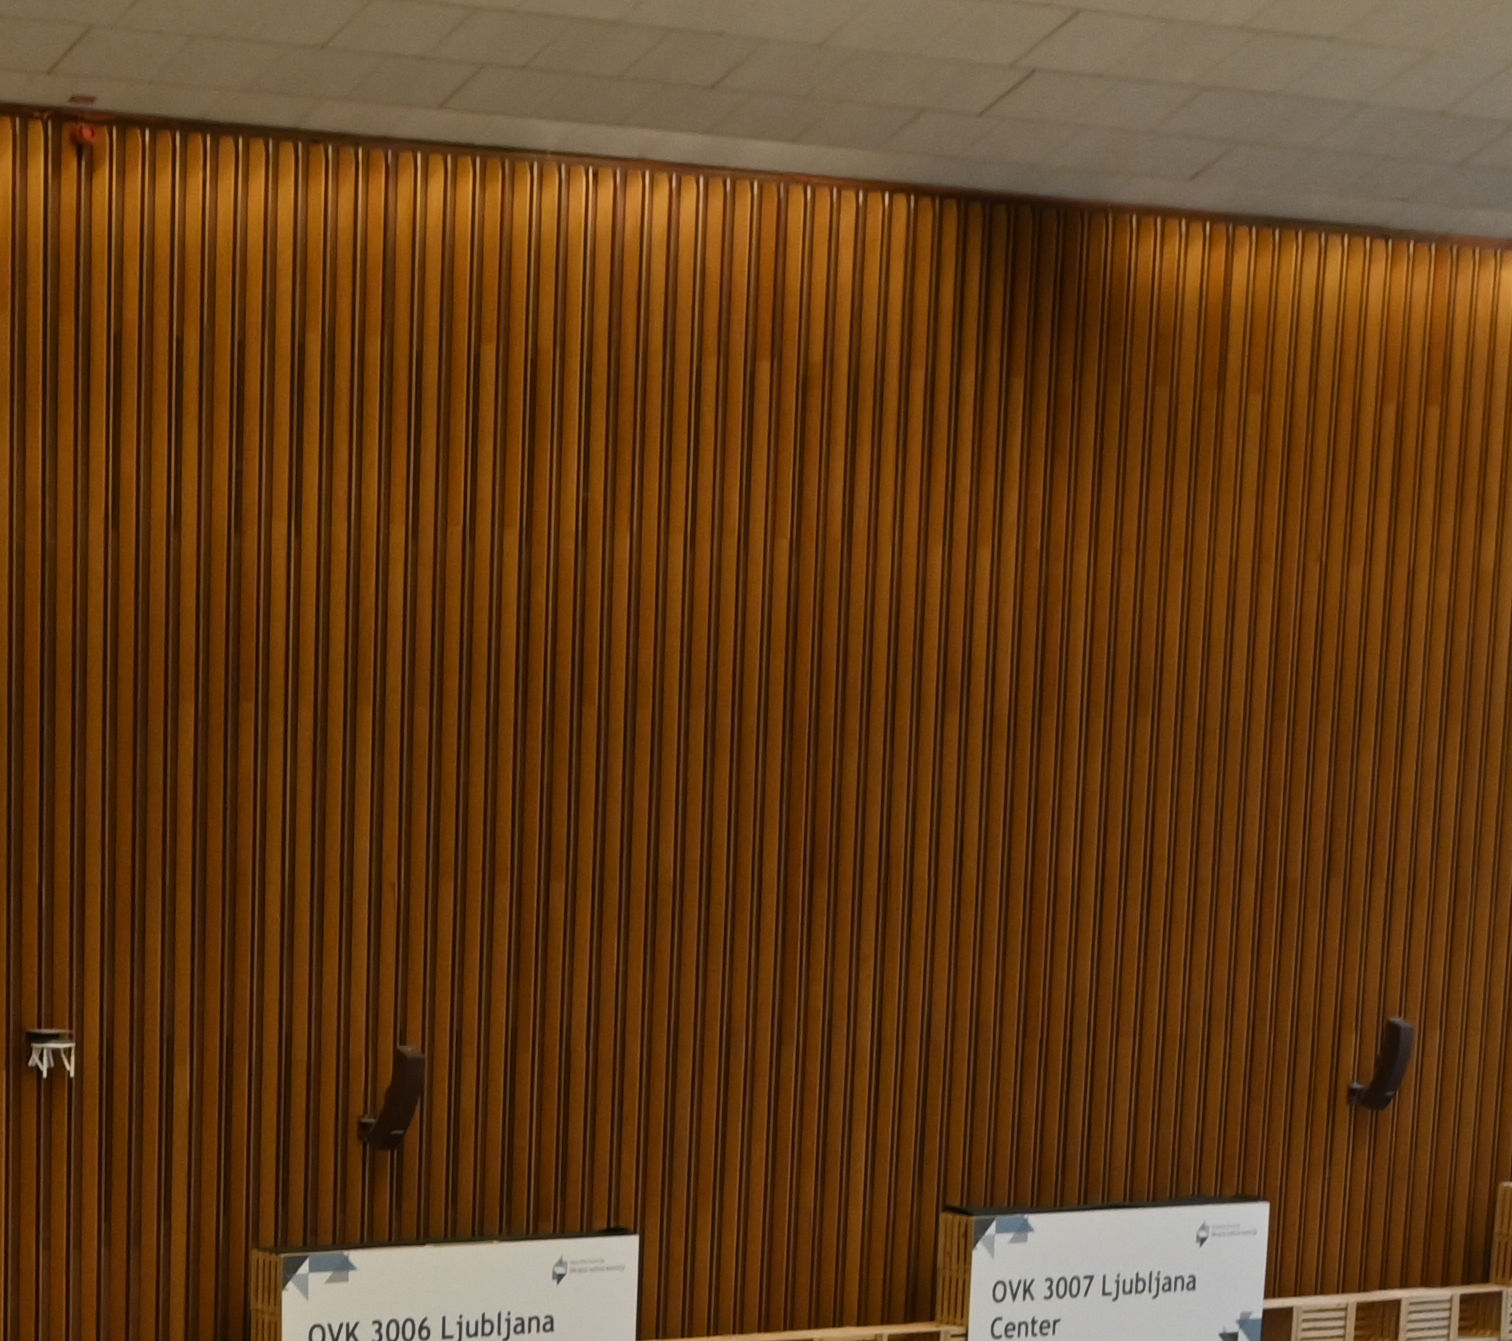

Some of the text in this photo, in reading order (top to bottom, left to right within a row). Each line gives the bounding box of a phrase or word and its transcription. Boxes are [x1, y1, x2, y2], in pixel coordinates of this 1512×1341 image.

[991, 1270, 1197, 1304] OVK 3007 Ljubljana
[990, 1316, 1061, 1340] Center
